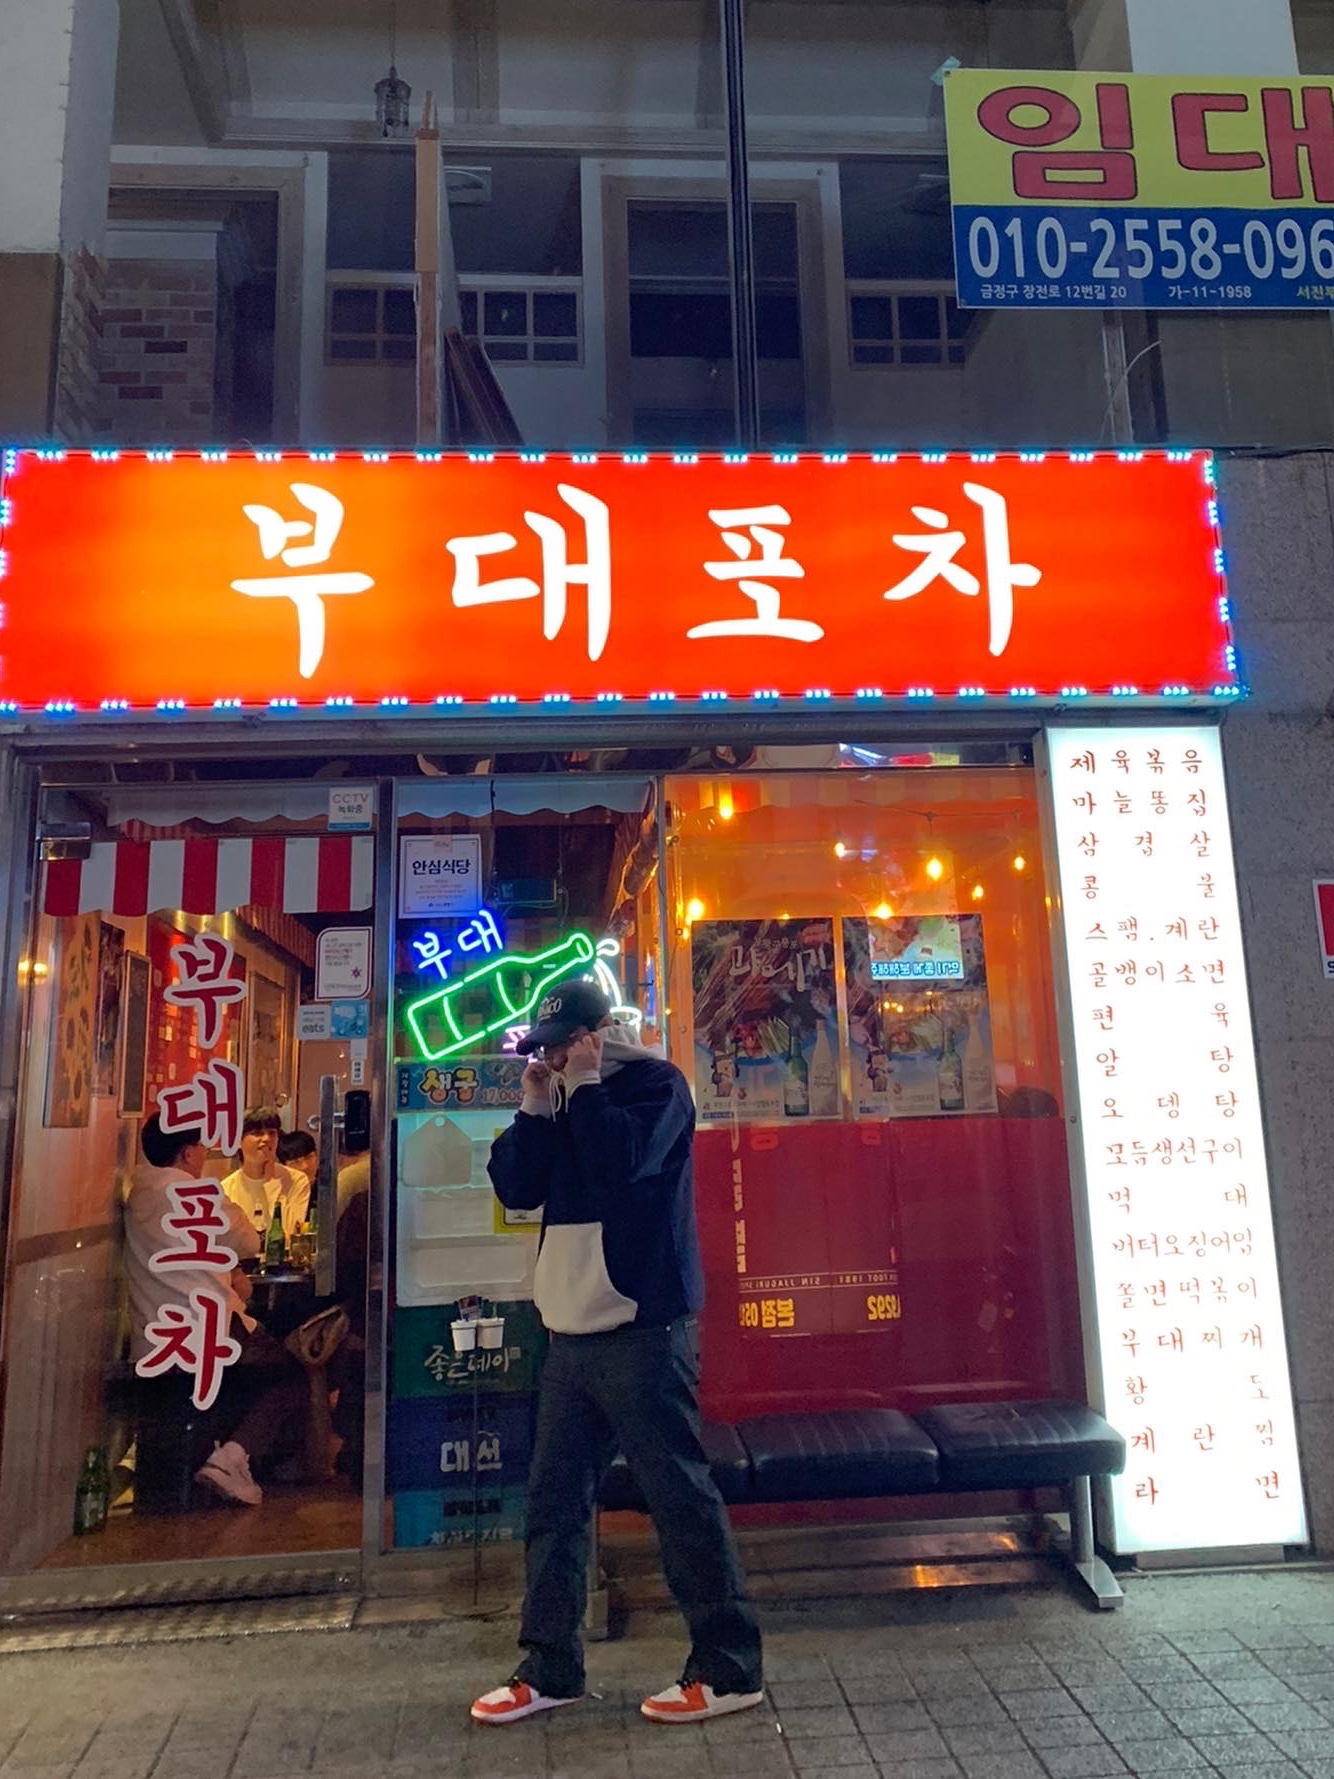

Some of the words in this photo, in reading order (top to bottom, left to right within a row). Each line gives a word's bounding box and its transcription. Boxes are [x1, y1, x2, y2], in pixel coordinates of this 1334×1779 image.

[977, 82, 1334, 203] 임대
[980, 285, 1019, 300] 금정구
[1022, 285, 1061, 300] 장전로
[1065, 284, 1106, 300] 12번길
[1110, 287, 1127, 299] 20
[1168, 285, 1253, 300] 가-11-1958
[230, 482, 1042, 679] 부대포차
[1069, 748, 1202, 775] 제육볶음
[332, 793, 369, 804] CCTV
[1071, 788, 1207, 817] 마늘똥집
[1077, 830, 1211, 857] 삼겹살
[412, 858, 472, 875] 안심식당
[412, 909, 504, 980] 부대
[1088, 959, 1226, 988] 골뱅이소면
[302, 1024, 325, 1033] eats
[1101, 1090, 1239, 1119] 오뎅탕
[1105, 1136, 1243, 1166] 모듬생선구이
[137, 935, 249, 1405] 부대포차
[1111, 1227, 1252, 1258] 버터오징어입
[1116, 1276, 1257, 1309] 쫄면떡볶이
[1121, 1323, 1263, 1358] 부대찌개
[1130, 1419, 1273, 1454] 계란찜
